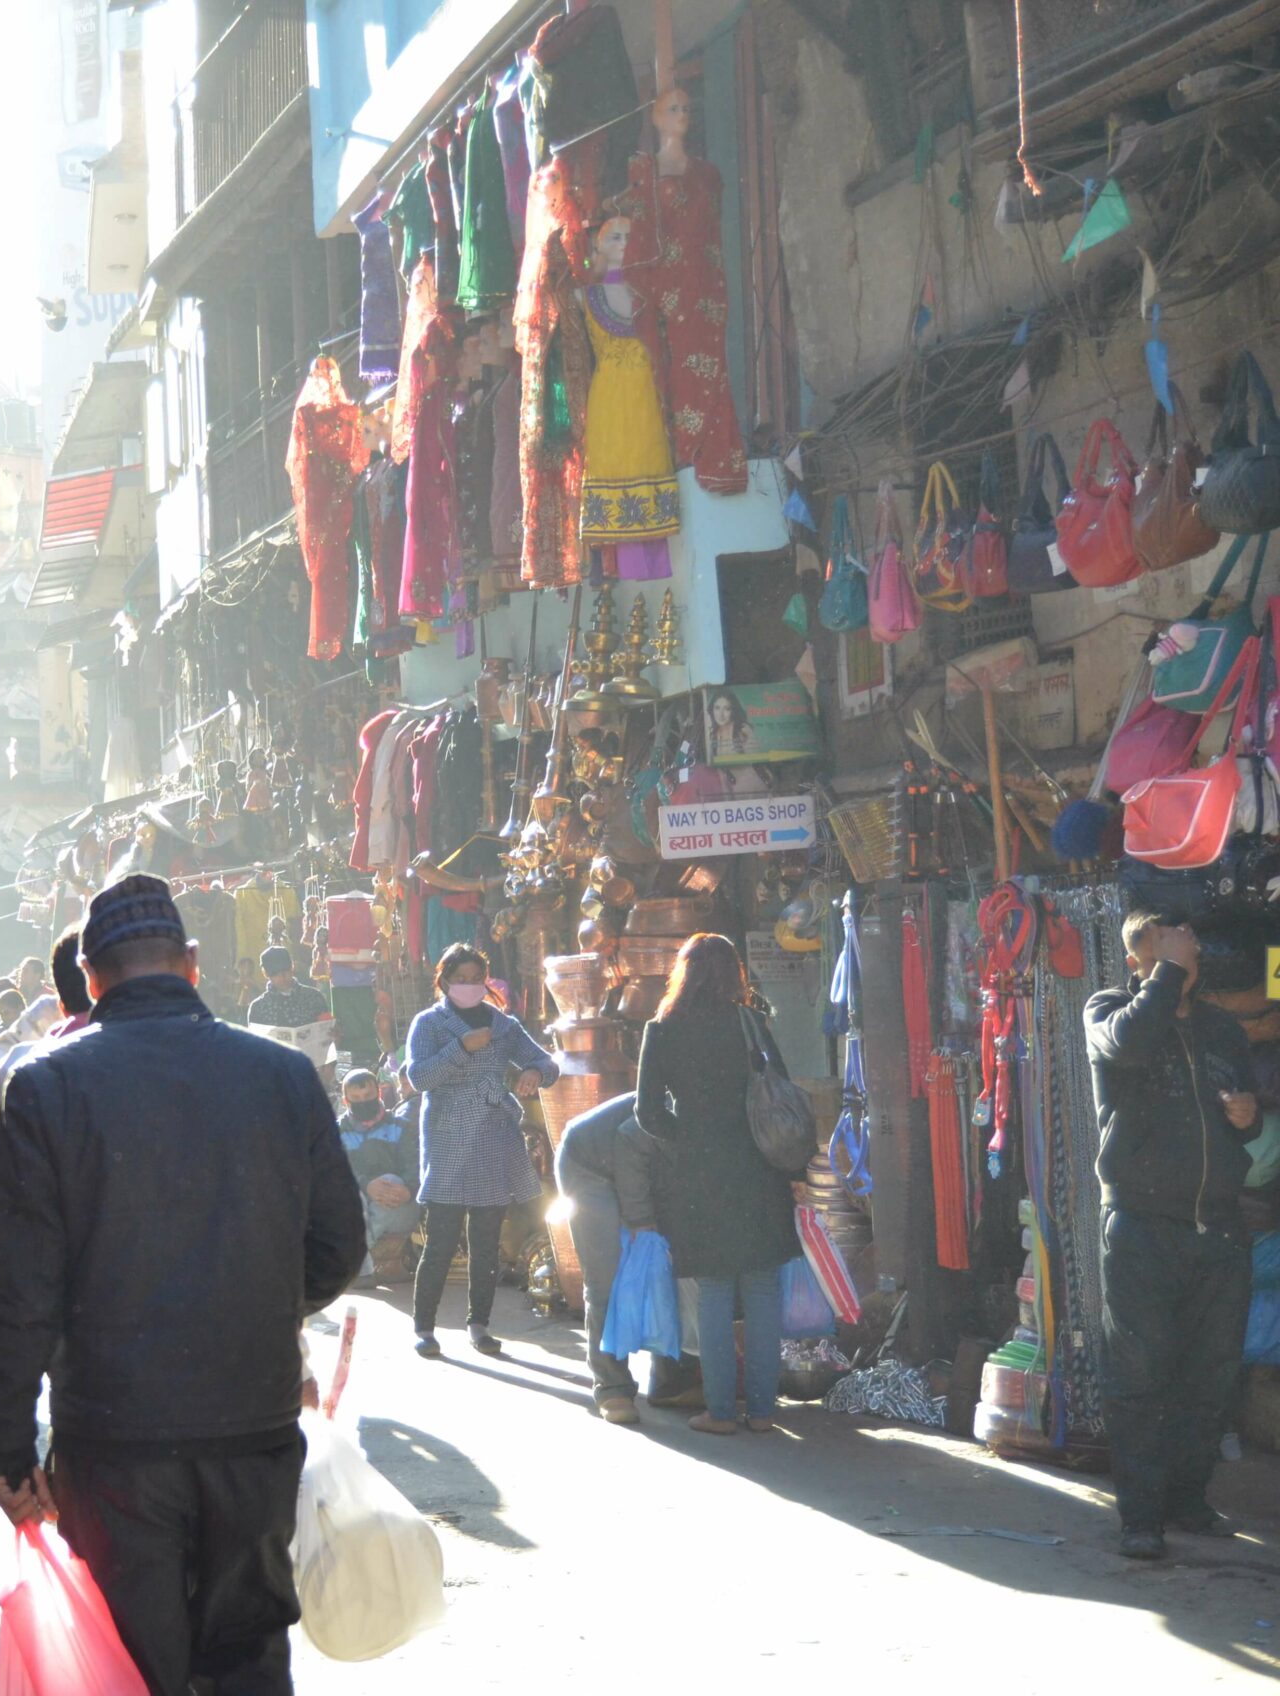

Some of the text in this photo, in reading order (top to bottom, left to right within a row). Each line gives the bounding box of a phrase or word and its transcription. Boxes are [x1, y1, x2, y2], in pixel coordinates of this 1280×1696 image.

[667, 803, 807, 828] WAY TO BAGS SHOP
[668, 829, 769, 851] ब्याग पसल
